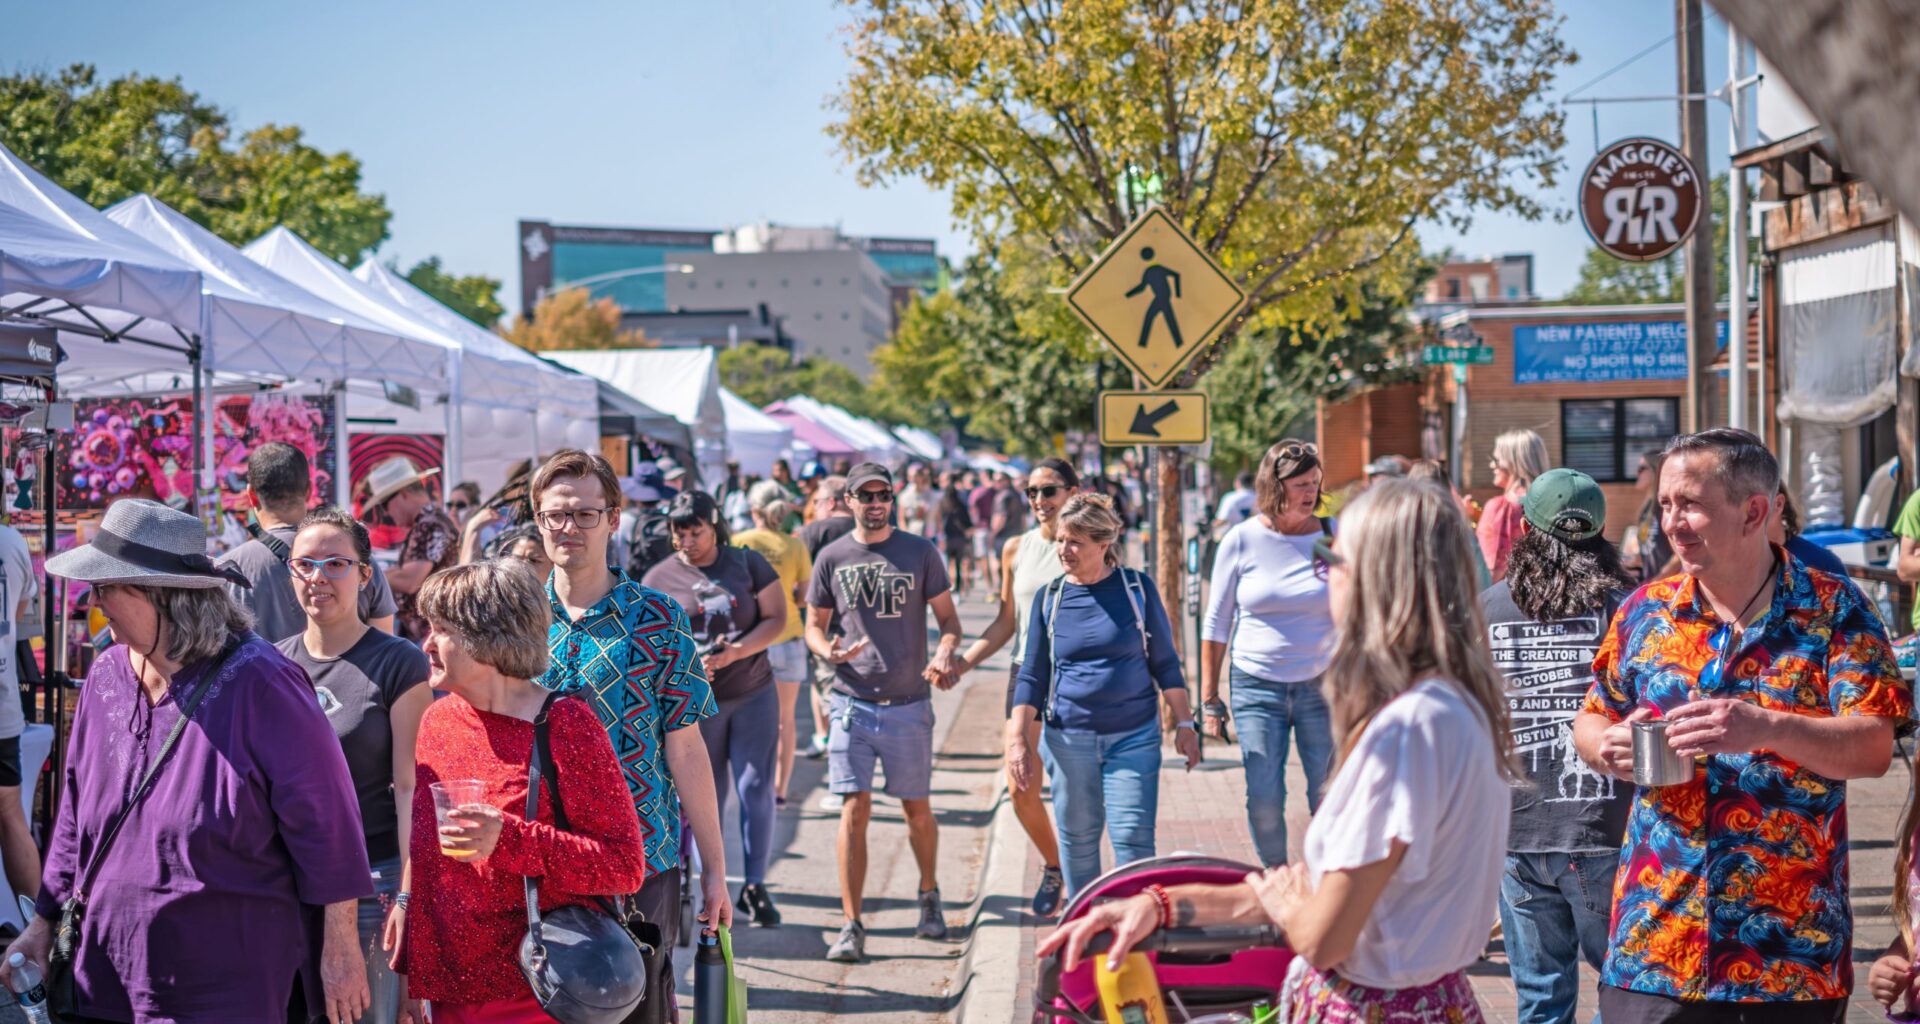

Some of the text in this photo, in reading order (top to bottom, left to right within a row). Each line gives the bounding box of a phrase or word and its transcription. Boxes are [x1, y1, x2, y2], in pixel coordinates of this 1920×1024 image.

[1590, 144, 1691, 190] MAGGIE'S
[1536, 321, 1725, 342] NEW PATIENTS WELCE
[1563, 356, 1587, 369] NO
[1633, 352, 1656, 367] NO
[1659, 352, 1688, 367] DRIL
[834, 561, 915, 619] WF
[1522, 624, 1568, 637] TYLER,
[1492, 649, 1578, 661] THE CREATOR
[1511, 667, 1573, 687] OCTOBER
[1521, 698, 1551, 710] AND
[1512, 727, 1555, 744] USTIN
